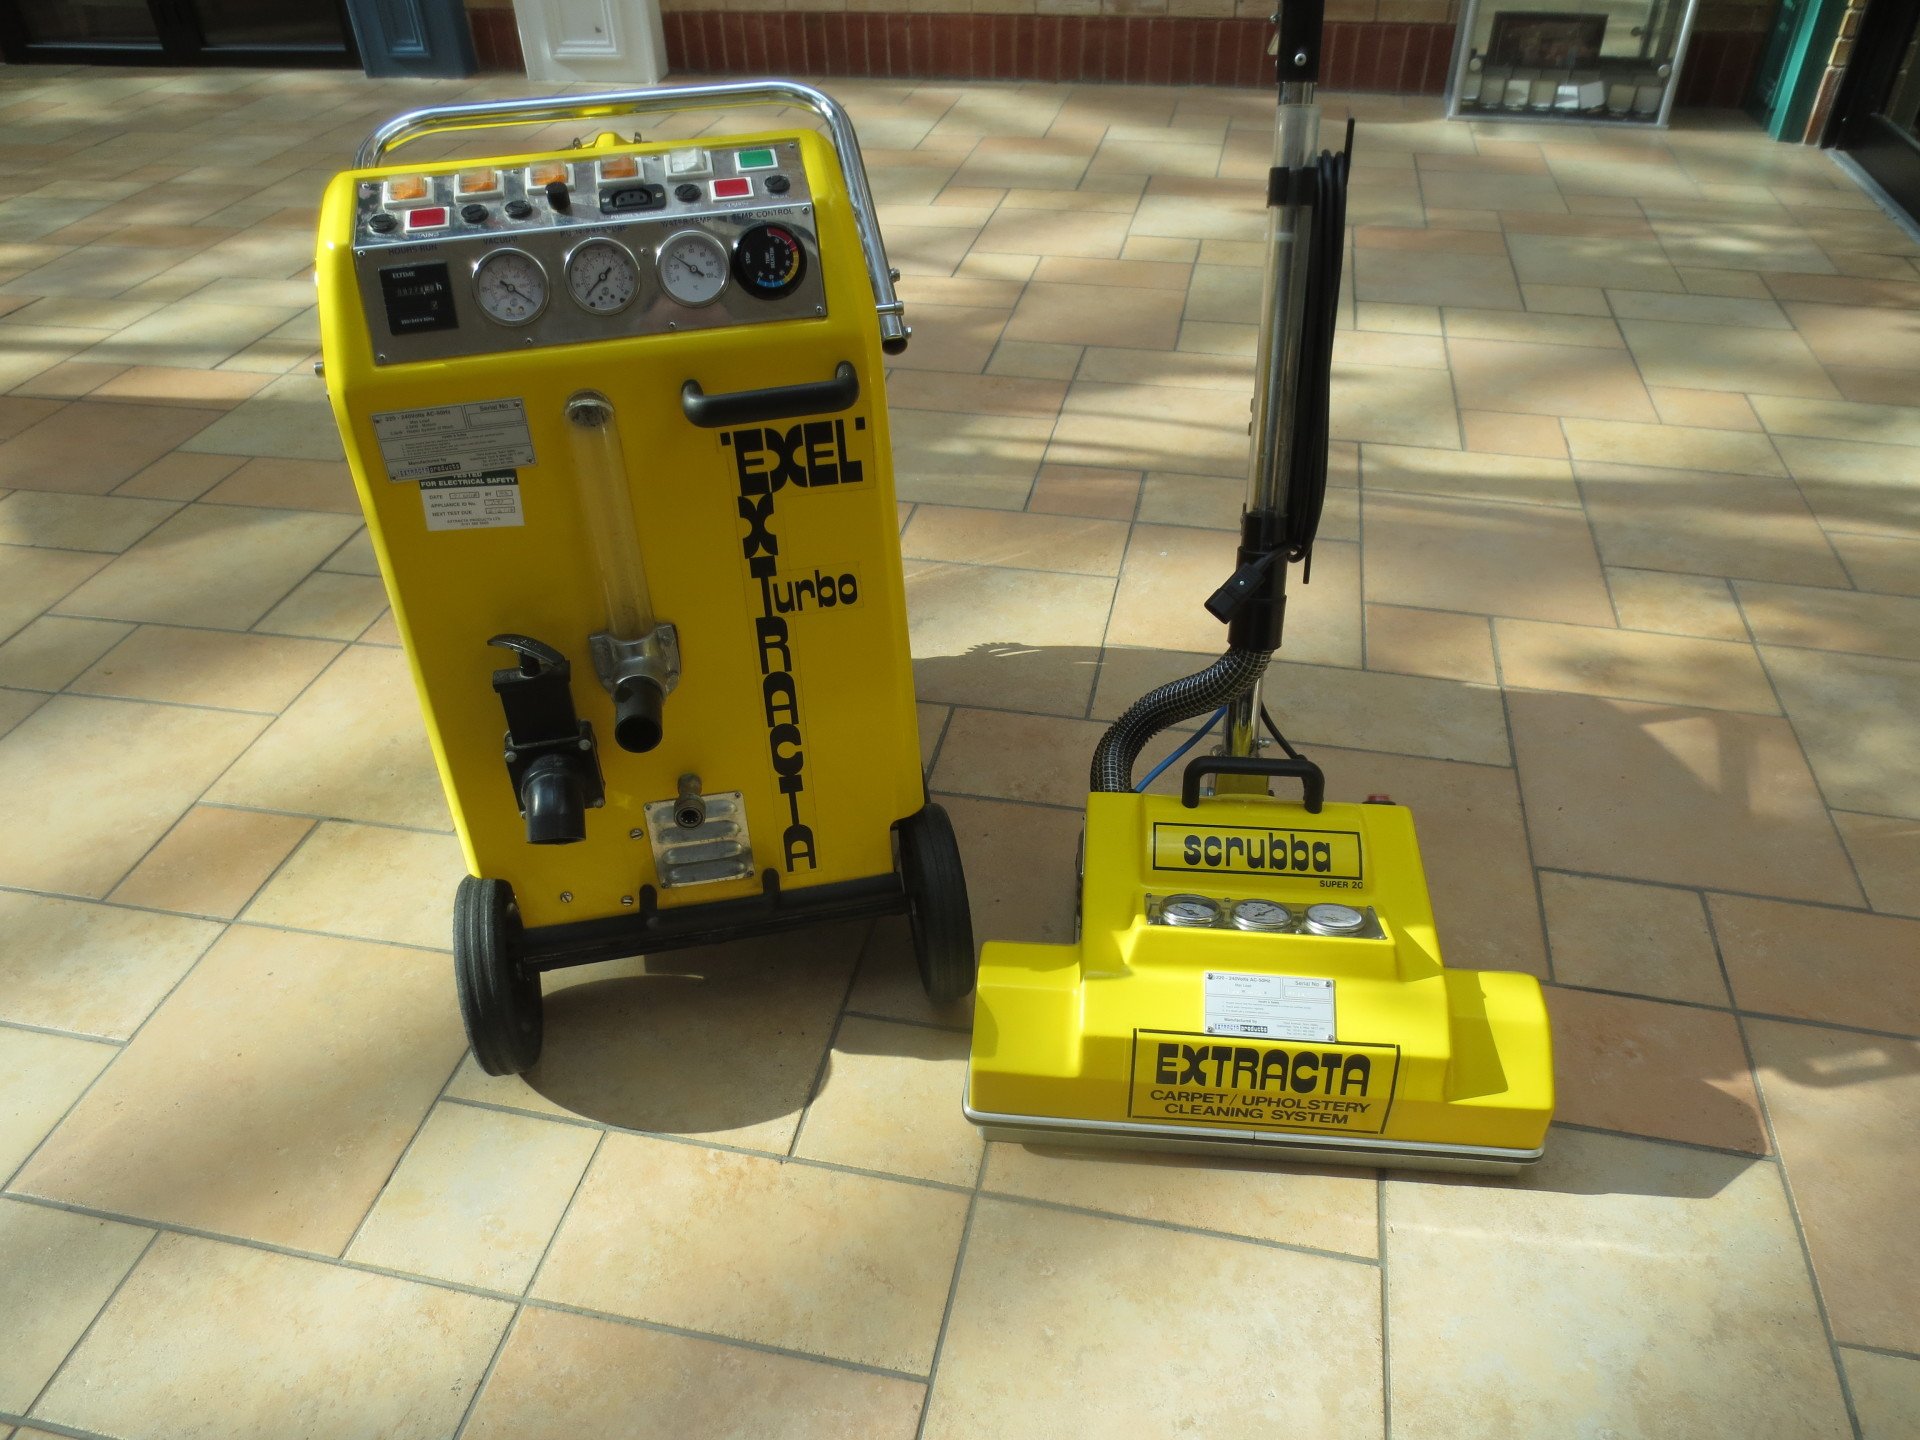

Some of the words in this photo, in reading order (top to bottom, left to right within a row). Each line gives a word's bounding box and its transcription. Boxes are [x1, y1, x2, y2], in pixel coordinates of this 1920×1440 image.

[757, 208, 793, 218] CONTROL
[483, 235, 519, 245] VACUUM
[388, 246, 417, 256] HOURS
[418, 243, 438, 252] RUN
[420, 480, 437, 488] FOR
[439, 478, 485, 487] ELECTRICAL
[487, 476, 516, 485] SAFETY
[1183, 832, 1332, 873] scrubba
[1319, 879, 1349, 889] SUPER
[1155, 1042, 1371, 1097] EXTRACTA
[1241, 1095, 1371, 1114] UPHOLSTERY
[1164, 1102, 1264, 1119] CLEANING
[1270, 1109, 1349, 1125] SYSTEM
